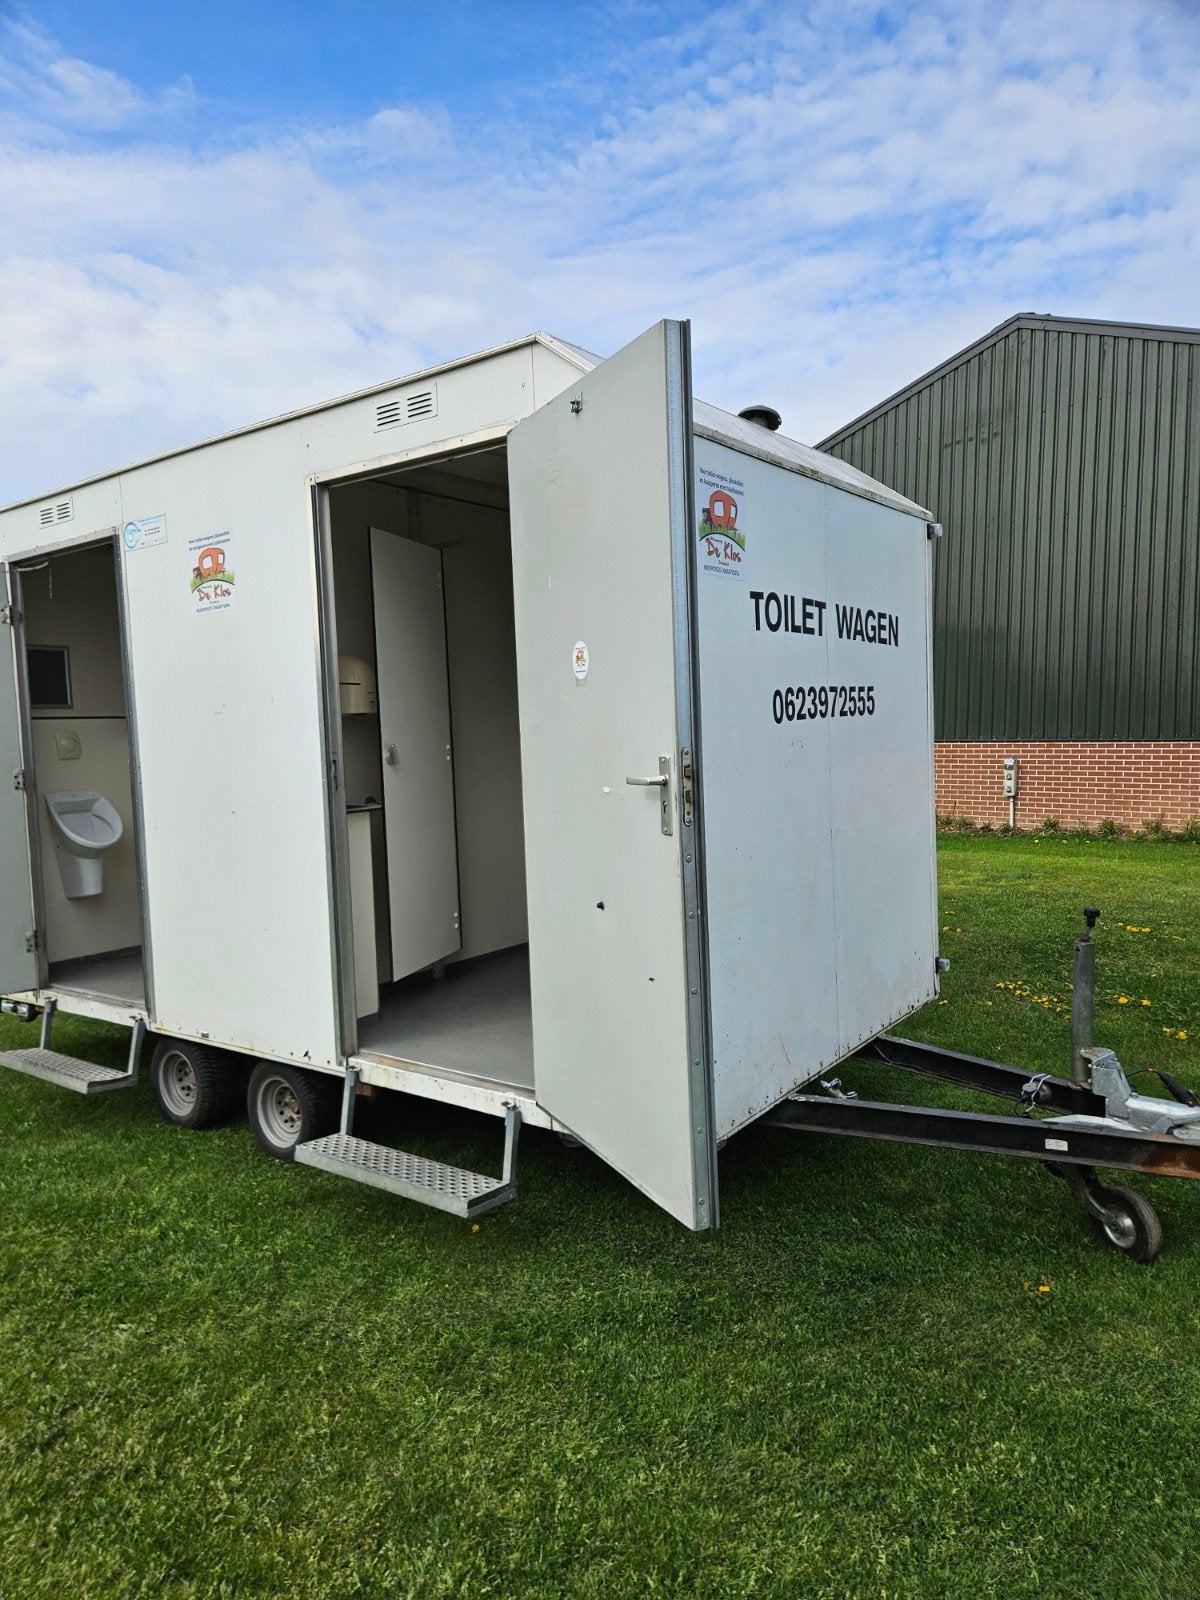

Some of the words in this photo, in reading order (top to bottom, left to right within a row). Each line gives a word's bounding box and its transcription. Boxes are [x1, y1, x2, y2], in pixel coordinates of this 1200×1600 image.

[705, 537, 721, 558] De
[724, 541, 742, 563] Klos
[213, 584, 231, 598] Klos
[750, 591, 827, 636] TOILET
[835, 603, 899, 648] WAGEN
[773, 686, 875, 725] 0623972555
